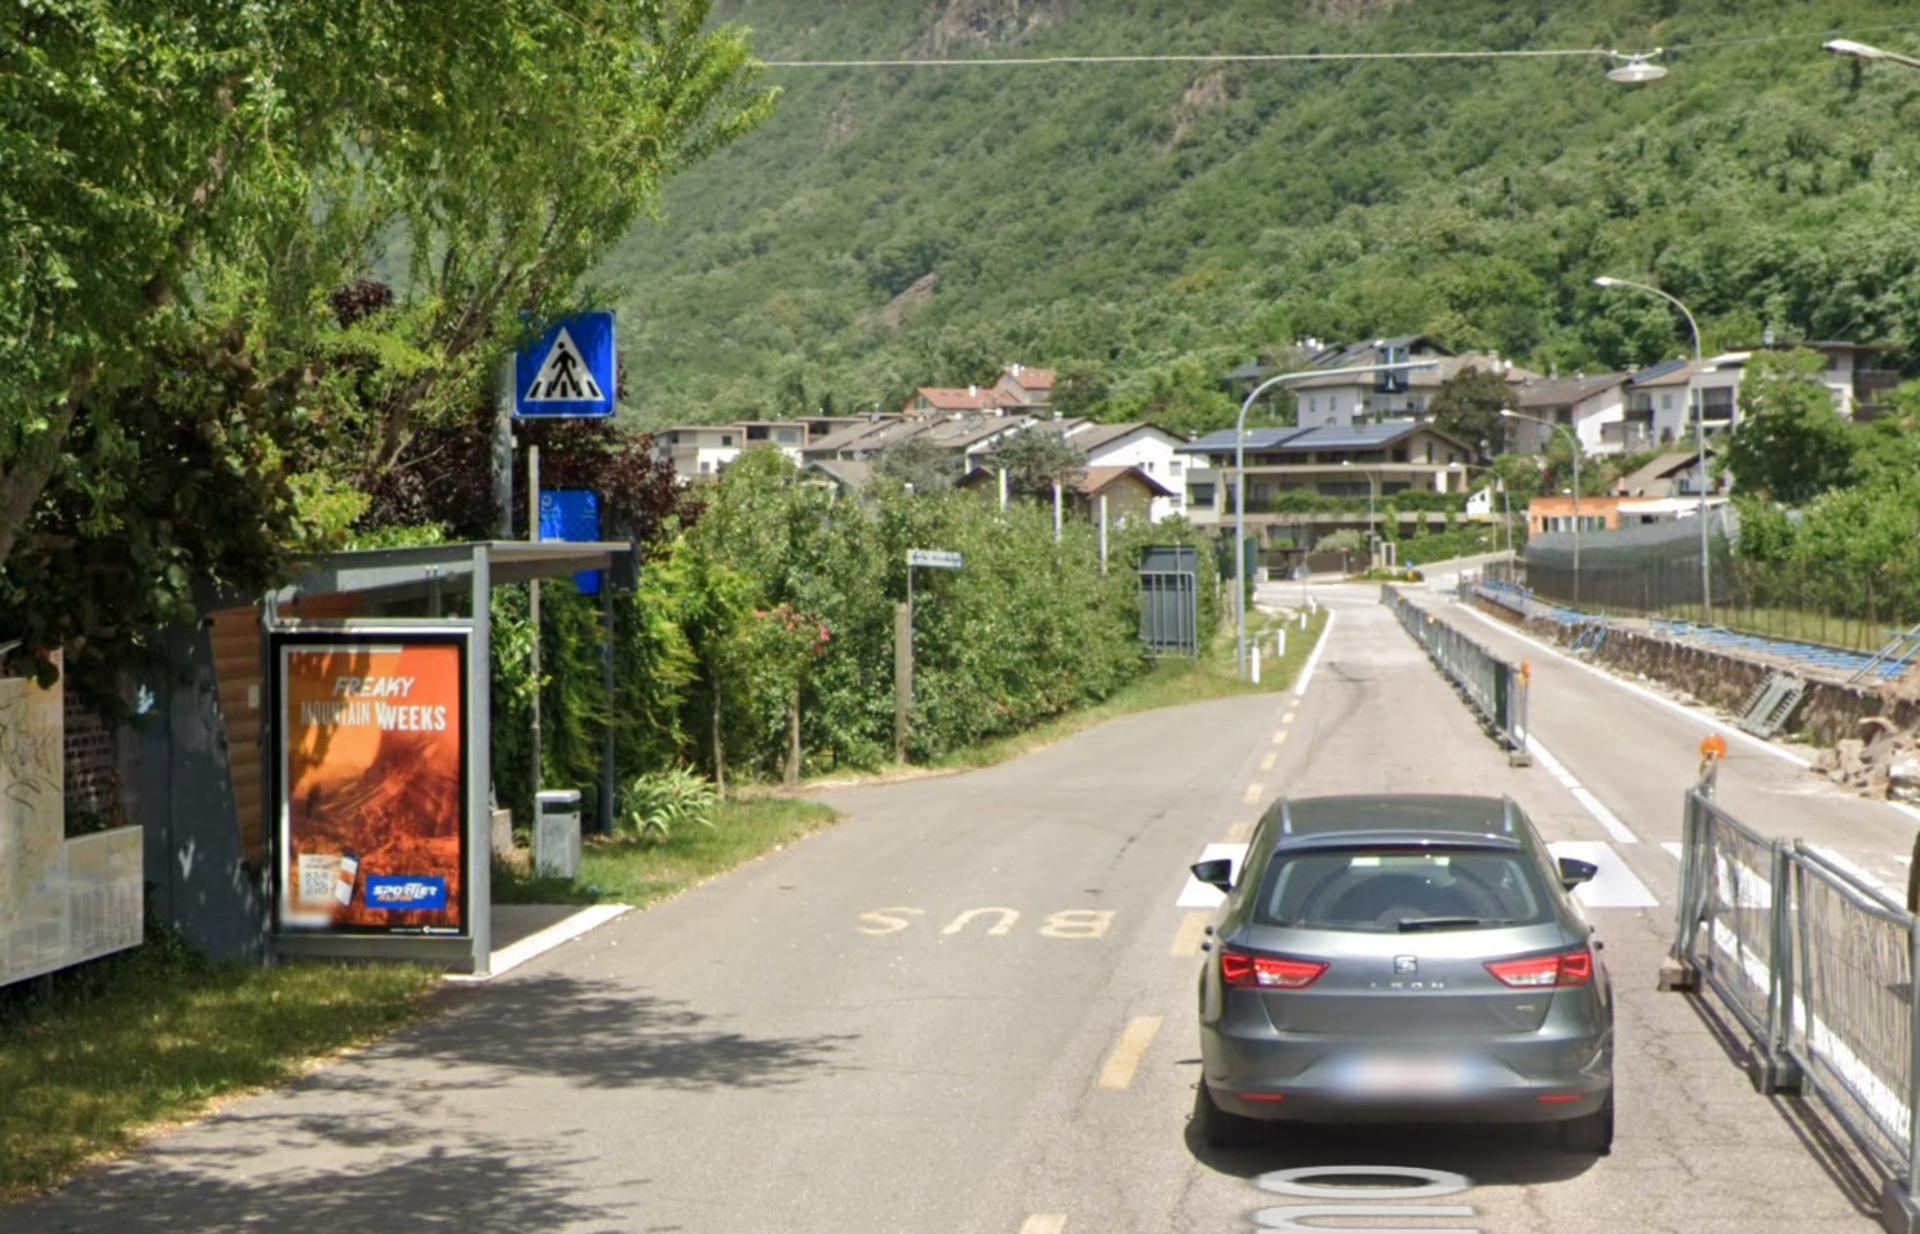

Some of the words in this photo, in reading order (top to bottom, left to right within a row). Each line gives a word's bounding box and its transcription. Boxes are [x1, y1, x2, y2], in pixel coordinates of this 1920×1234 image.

[333, 676, 415, 698] FREAKY
[302, 702, 372, 726] MOUNTAIN
[375, 702, 447, 731] WEEKS
